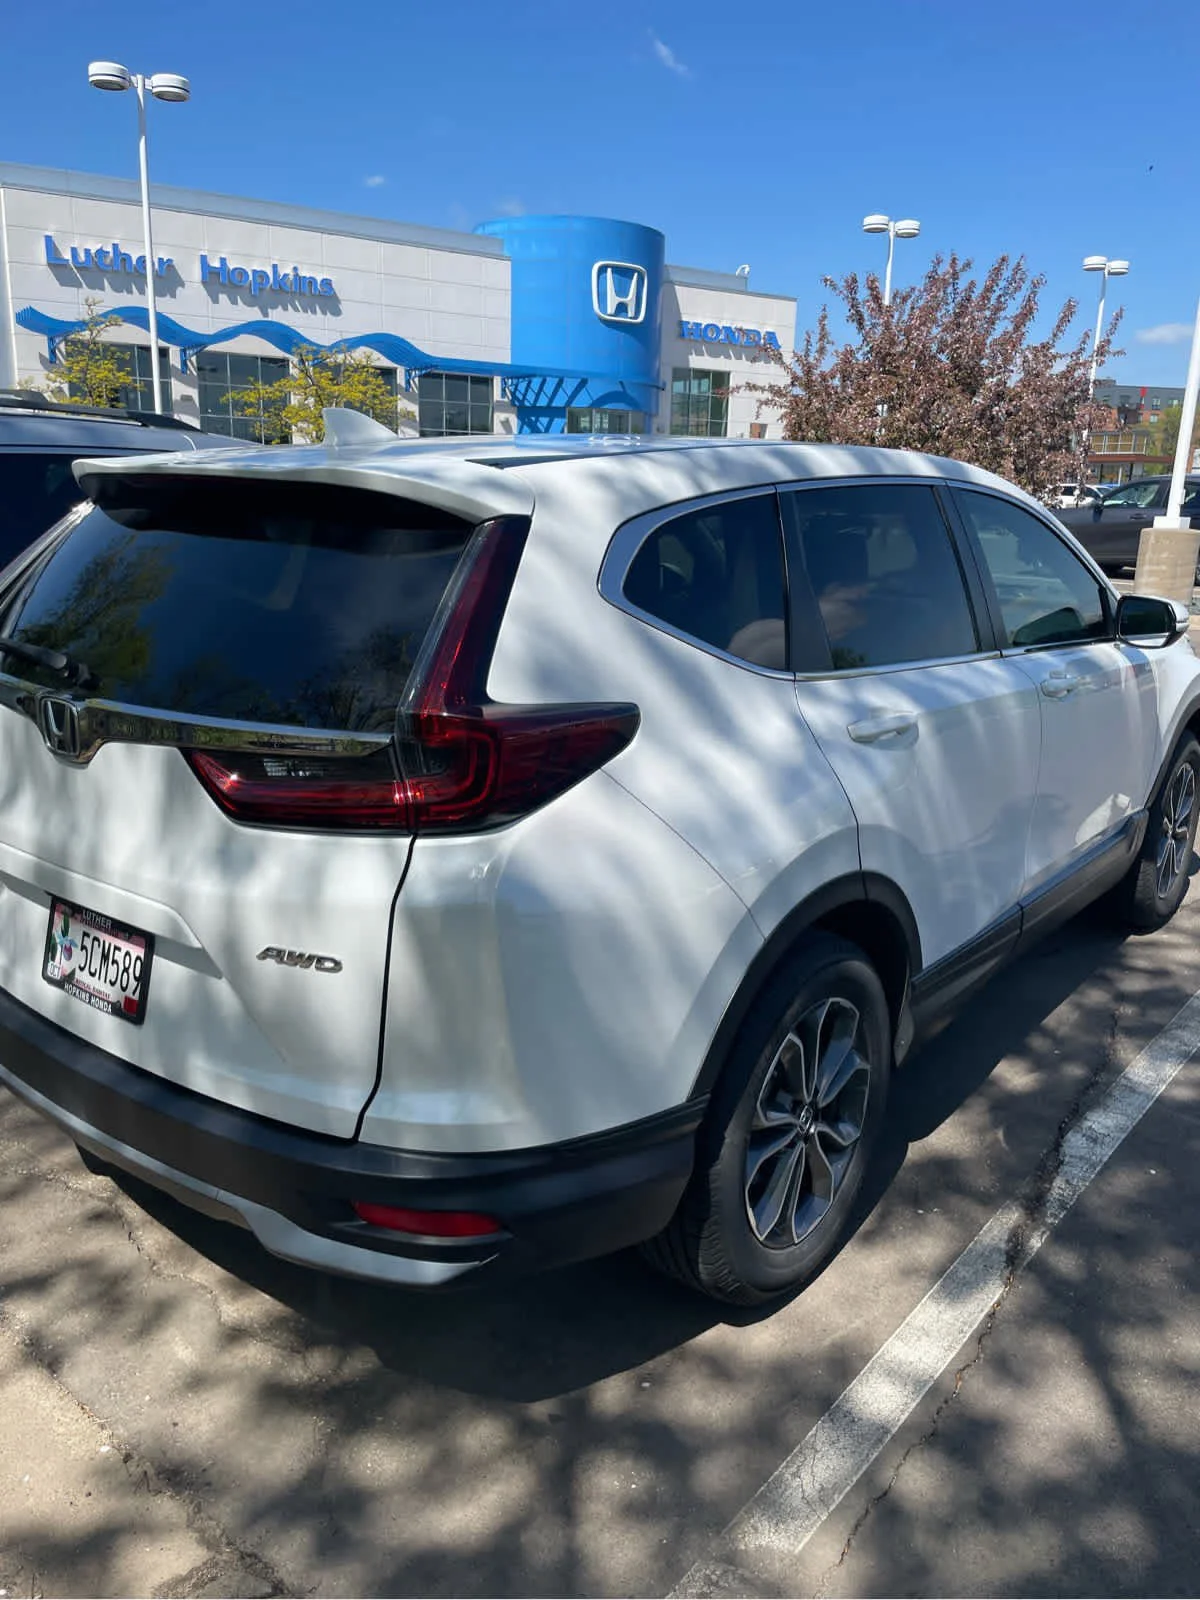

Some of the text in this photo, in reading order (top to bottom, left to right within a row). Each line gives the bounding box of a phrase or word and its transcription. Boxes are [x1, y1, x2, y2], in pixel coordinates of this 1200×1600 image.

[199, 253, 333, 297] Hopkins
[679, 320, 781, 350] HONDA
[82, 909, 112, 929] LUTHER
[78, 930, 144, 997] 5CM589
[256, 947, 343, 973] AWD
[64, 982, 91, 1004] HOPKINS
[91, 995, 112, 1013] HONDA
